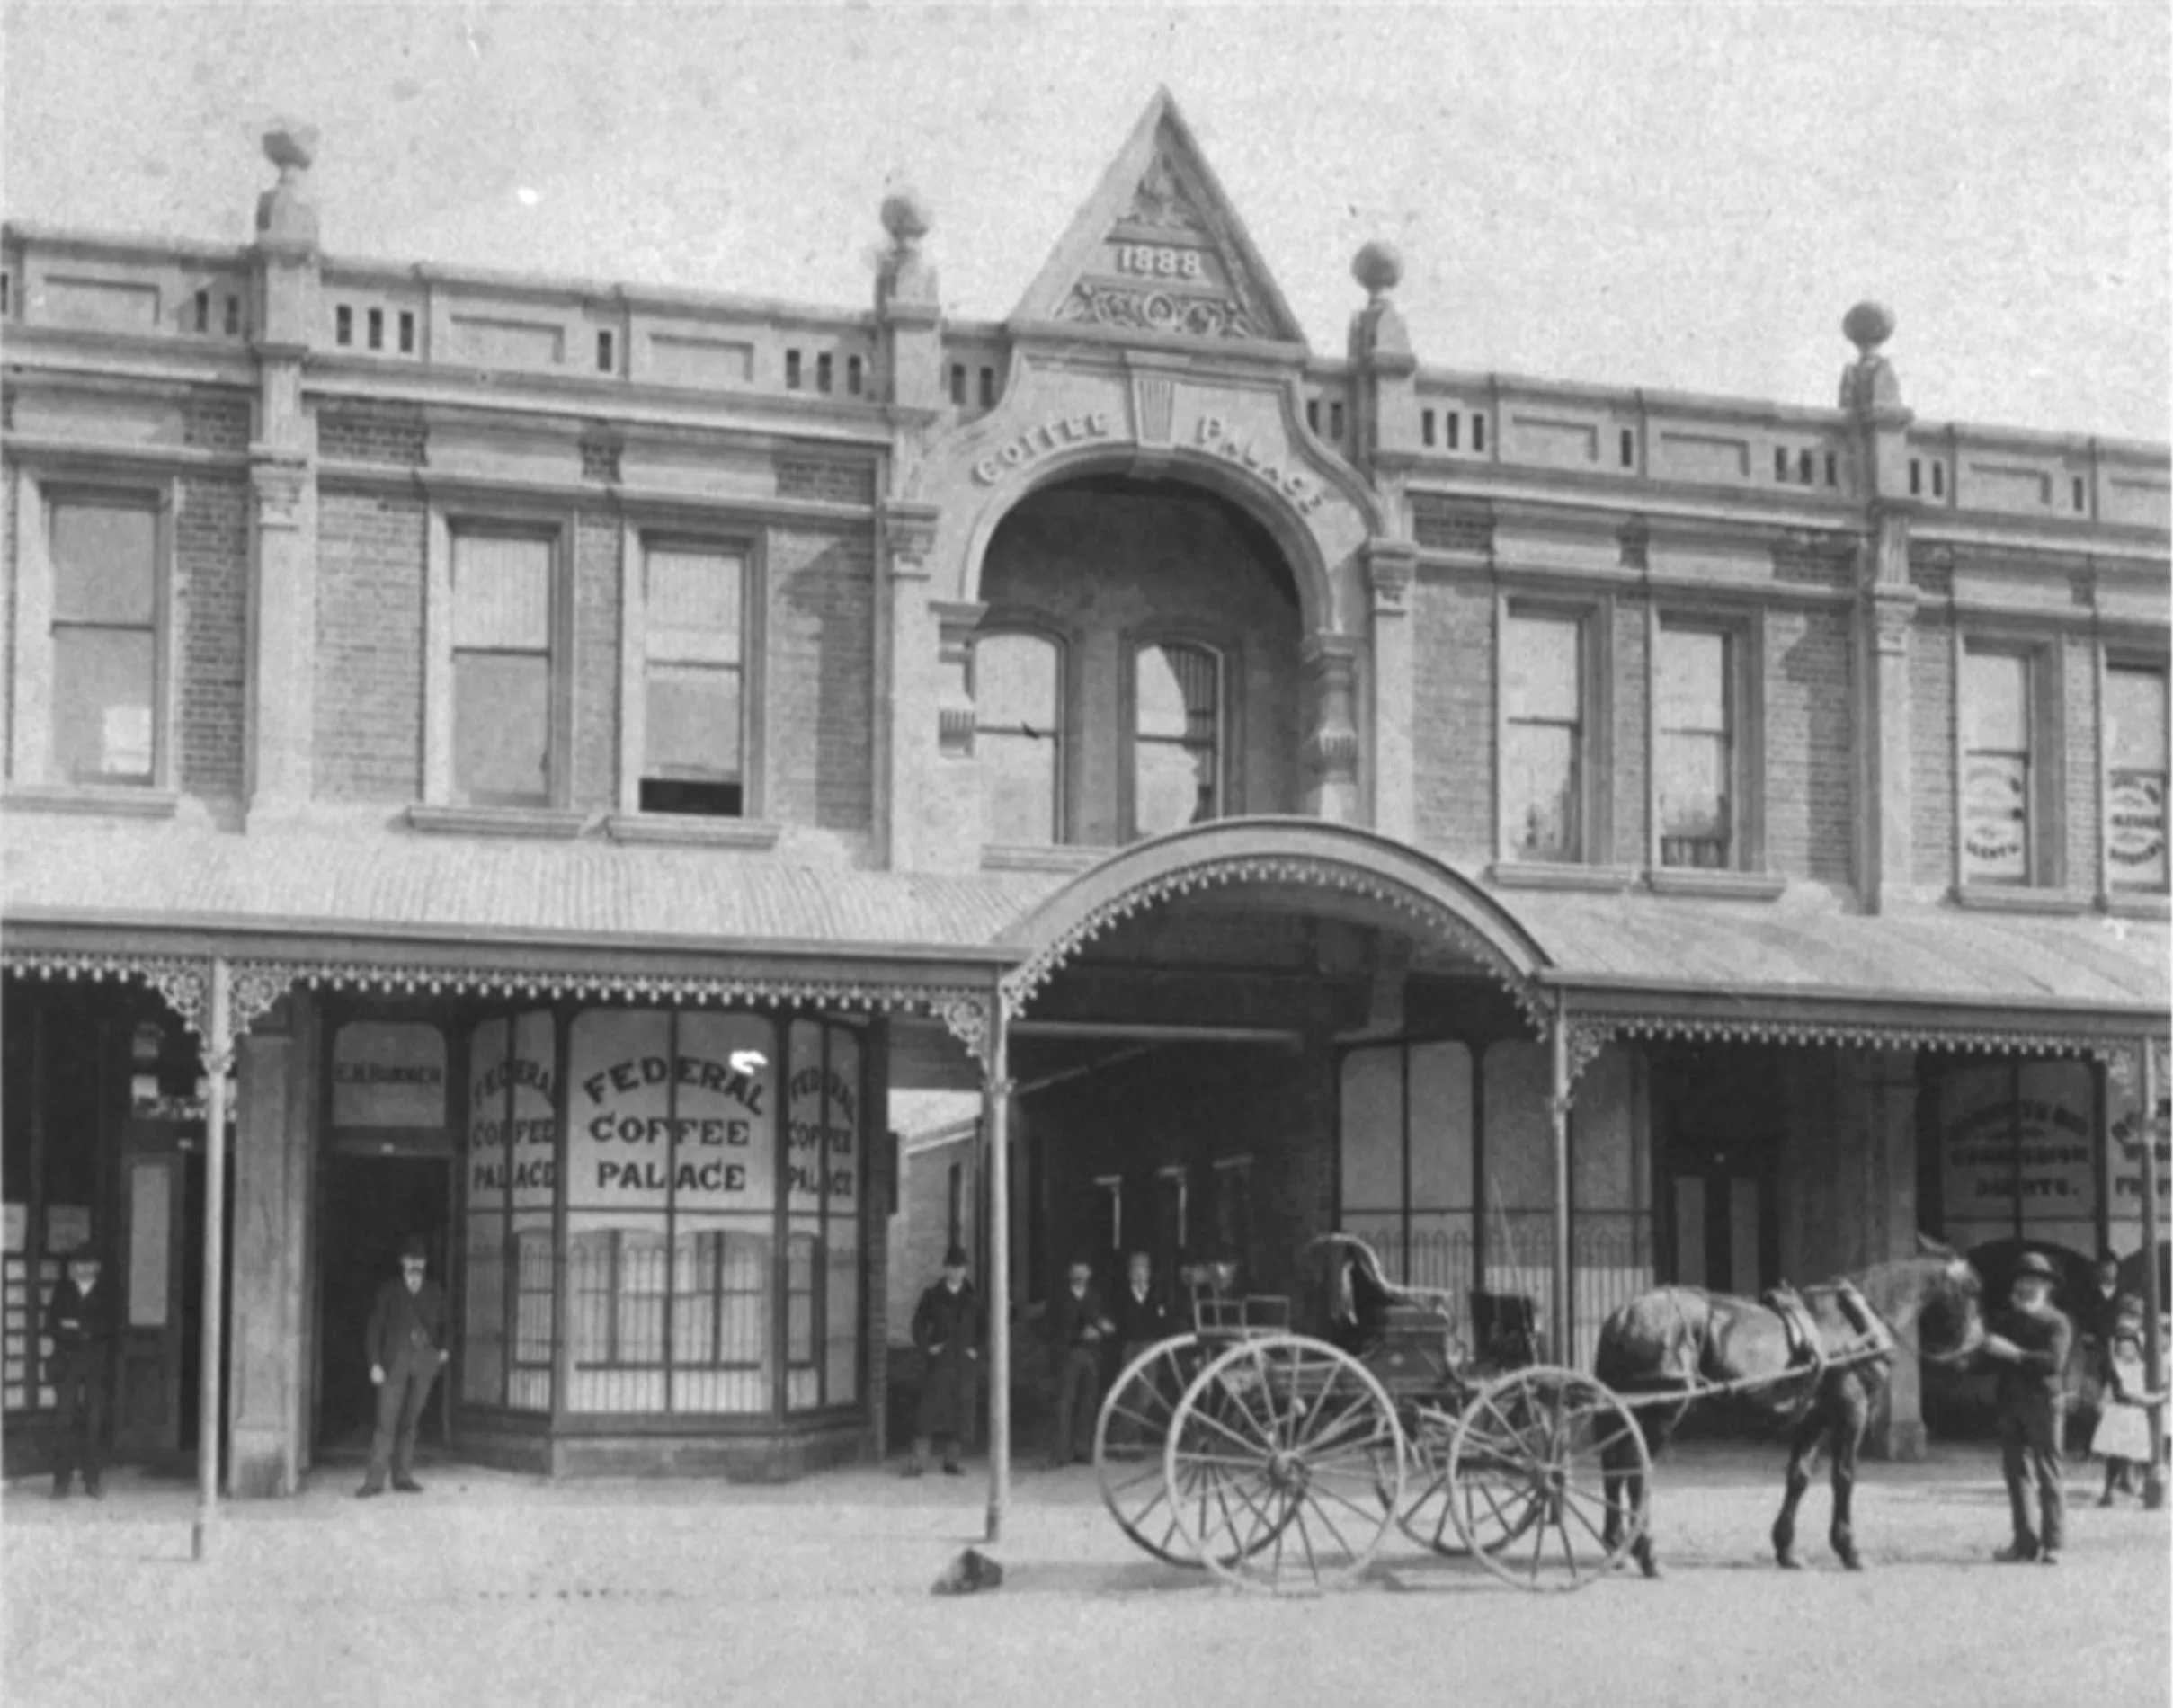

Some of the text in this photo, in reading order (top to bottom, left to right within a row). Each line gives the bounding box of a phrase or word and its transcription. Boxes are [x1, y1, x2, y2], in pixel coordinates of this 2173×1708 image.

[1118, 244, 1202, 277] 1888
[971, 412, 1324, 516] COFFEE PALACE
[583, 1054, 764, 1117] FEDERAL
[588, 1111, 751, 1148] COFFEE
[596, 1159, 746, 1192] PALACE
